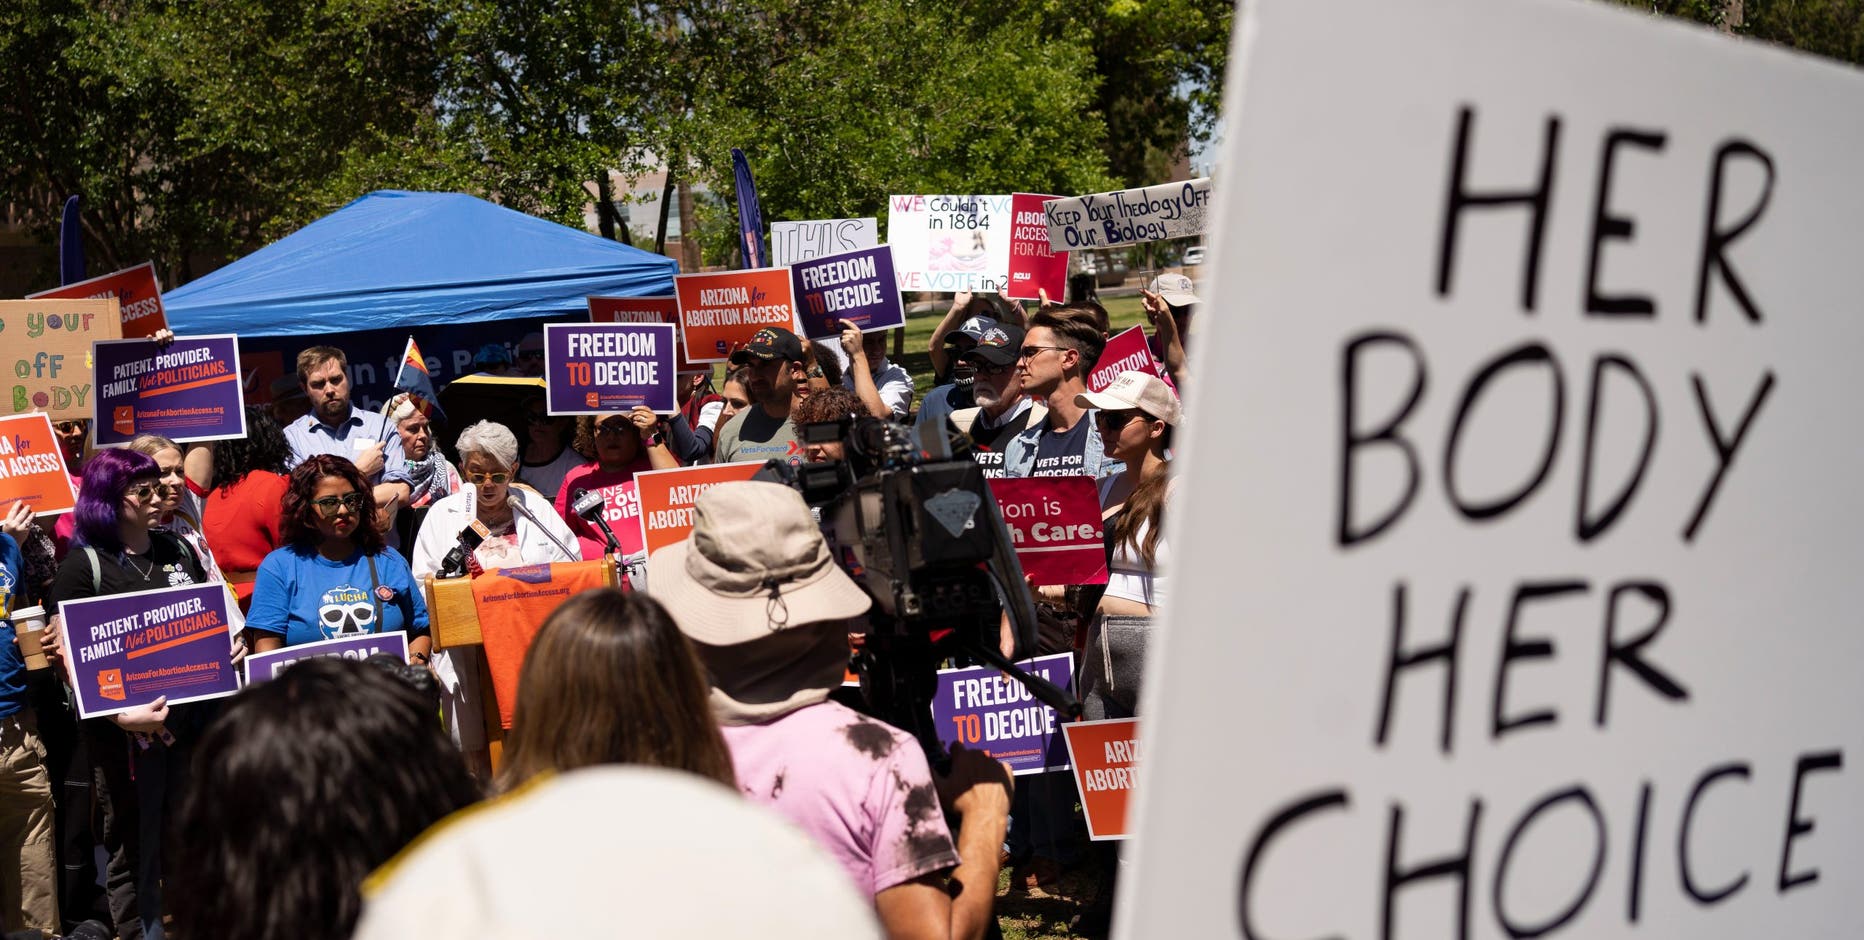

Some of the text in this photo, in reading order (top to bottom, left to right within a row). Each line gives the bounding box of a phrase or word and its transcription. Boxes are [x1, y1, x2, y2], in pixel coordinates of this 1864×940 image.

[892, 195, 925, 213] WE
[930, 198, 988, 213] Couldn't
[1080, 195, 1116, 222] Your
[1435, 104, 1776, 325] HER
[929, 213, 990, 230] in 1864
[1064, 225, 1098, 247] Our
[1102, 218, 1168, 244] Biology
[772, 219, 864, 266] THIS
[1014, 242, 1035, 256] FOR
[801, 255, 877, 290] FREEDOM
[924, 272, 977, 289] VOTE
[981, 275, 995, 290] in
[700, 286, 767, 307] ARIZONA for
[805, 281, 884, 315] TO DECIDE
[27, 312, 95, 338] your
[686, 308, 741, 327] ABORTION
[742, 304, 790, 325] ACCESS
[568, 332, 656, 357] FREEDOM
[113, 347, 214, 380] PATIENT. PROVIDER.
[566, 361, 659, 386] TO DECIDE
[102, 360, 229, 399] FAMILY. Not POLITICIANS.
[15, 434, 31, 457] for
[1334, 330, 1777, 549] BODY
[9, 452, 60, 477] ACCESS
[972, 452, 1004, 465] VETS
[1036, 455, 1083, 468] VETS FOR
[574, 498, 590, 512] FOX
[589, 493, 599, 506] 10
[1042, 496, 1062, 516] is
[1031, 522, 1104, 542] Care.
[90, 597, 206, 642] PATIENT. PROVIDER.
[79, 610, 221, 663] FAMILY. Not POLITICIANS.
[125, 660, 220, 682] ArizonaForAbortionAccess.org
[1373, 578, 1691, 756] HER
[952, 705, 1057, 744] TO DECIDE
[1238, 746, 1844, 940] CHOICE
